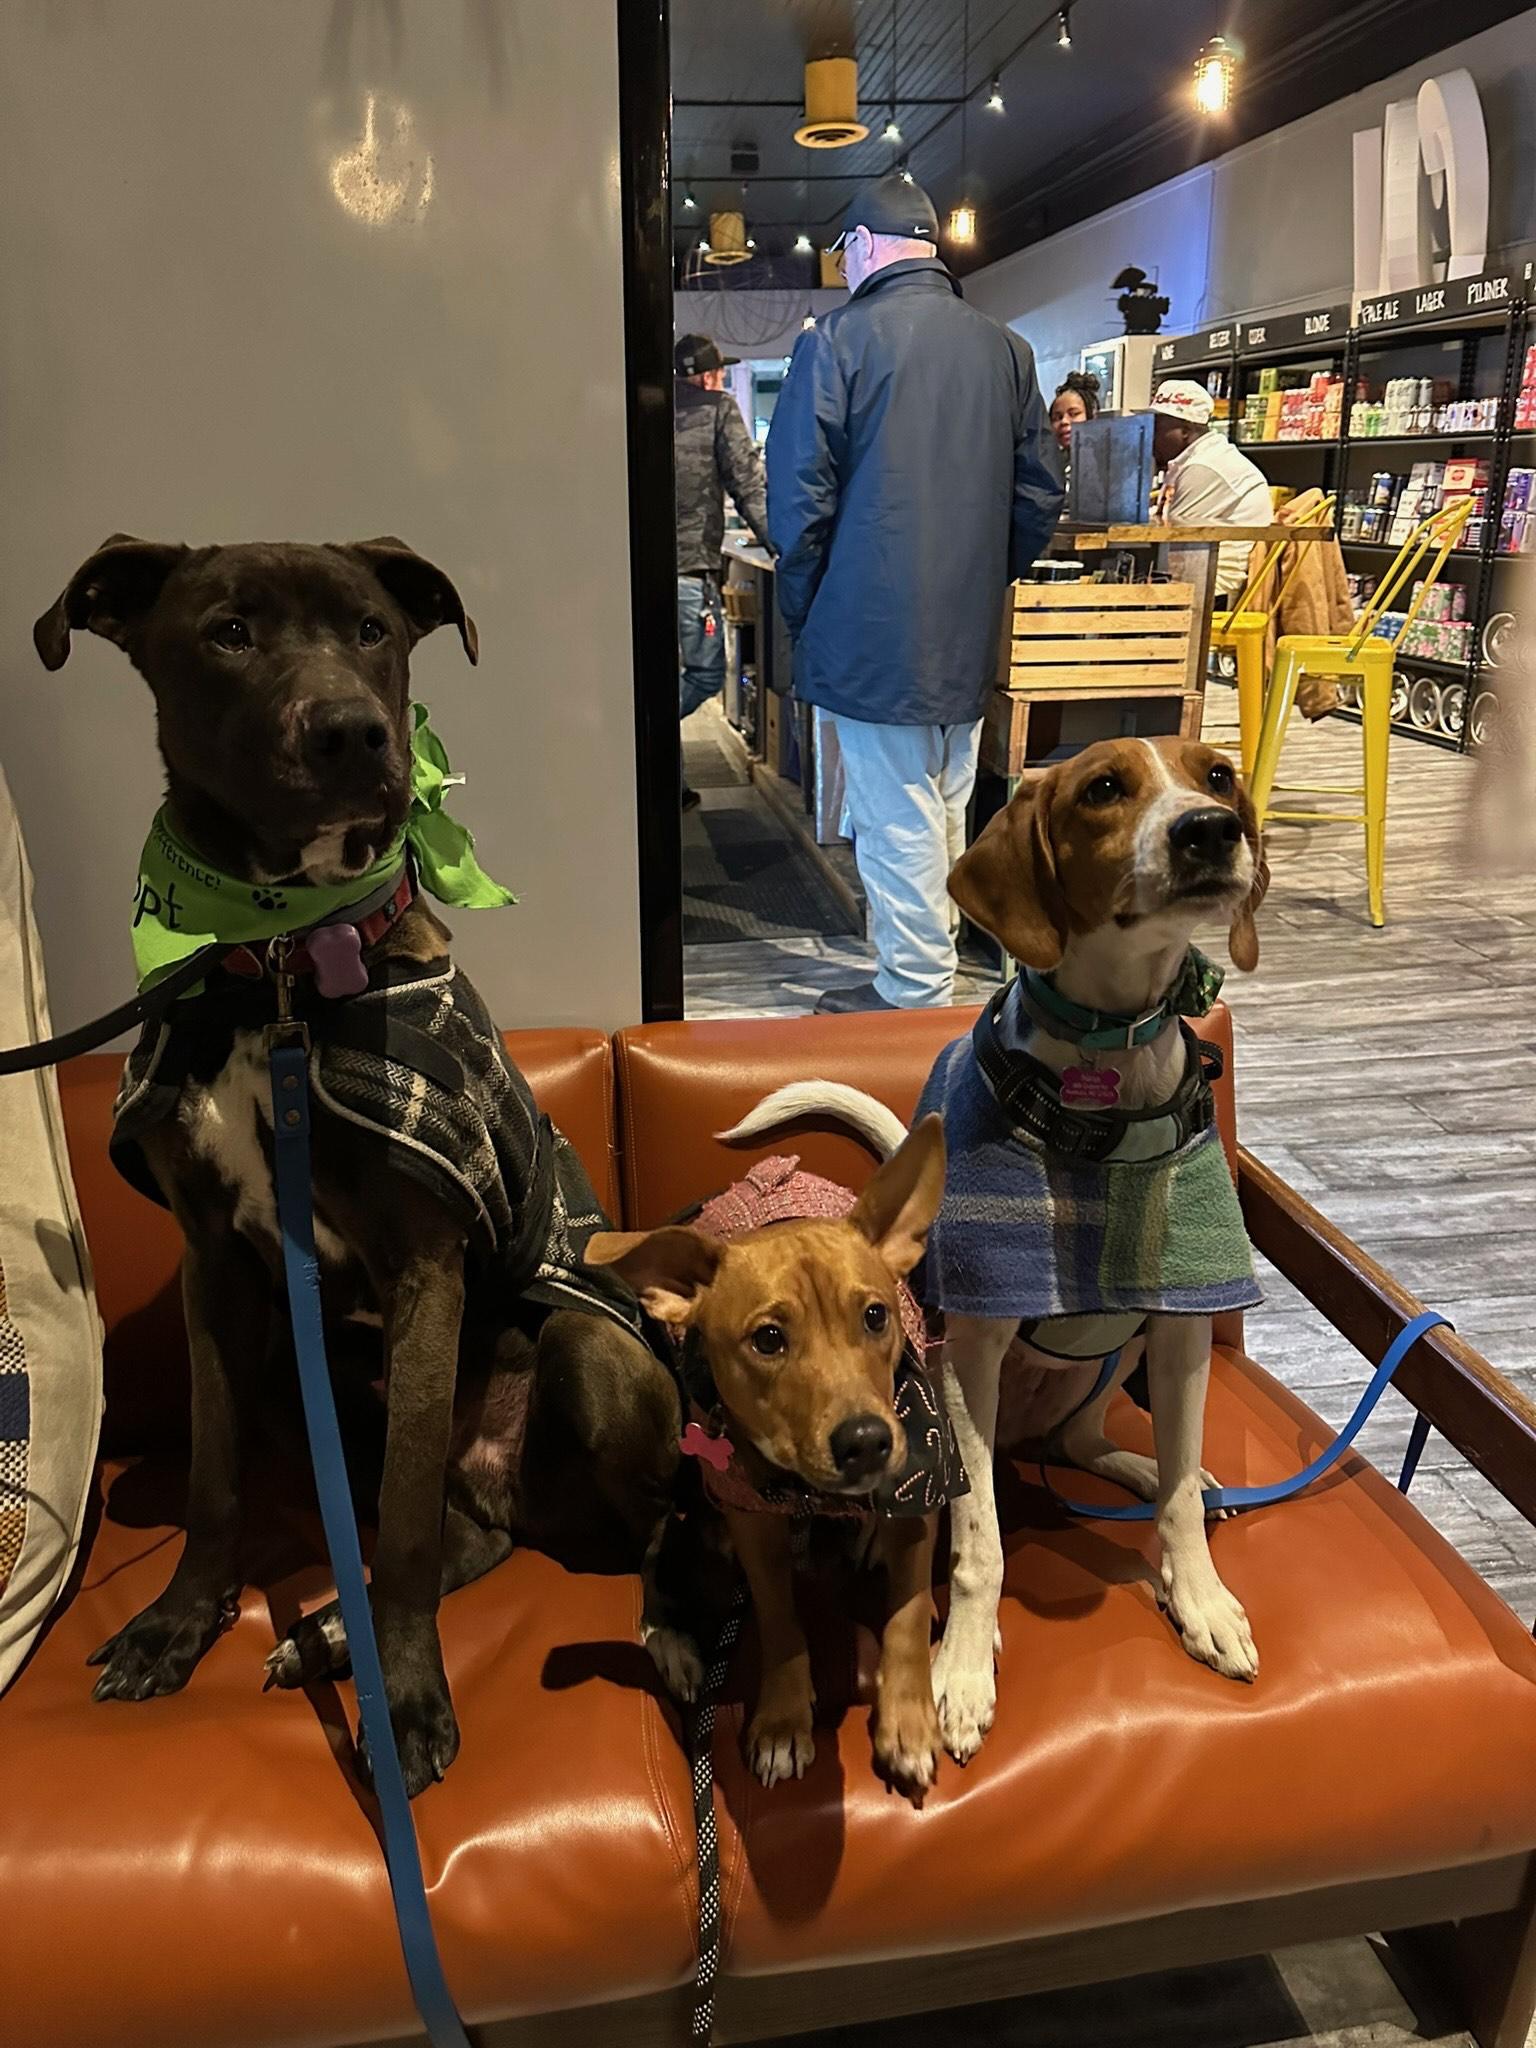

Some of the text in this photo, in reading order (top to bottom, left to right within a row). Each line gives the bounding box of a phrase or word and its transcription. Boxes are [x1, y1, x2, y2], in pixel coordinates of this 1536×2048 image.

[1362, 300, 1400, 325] PALE ALE
[1415, 289, 1445, 314] LAGER
